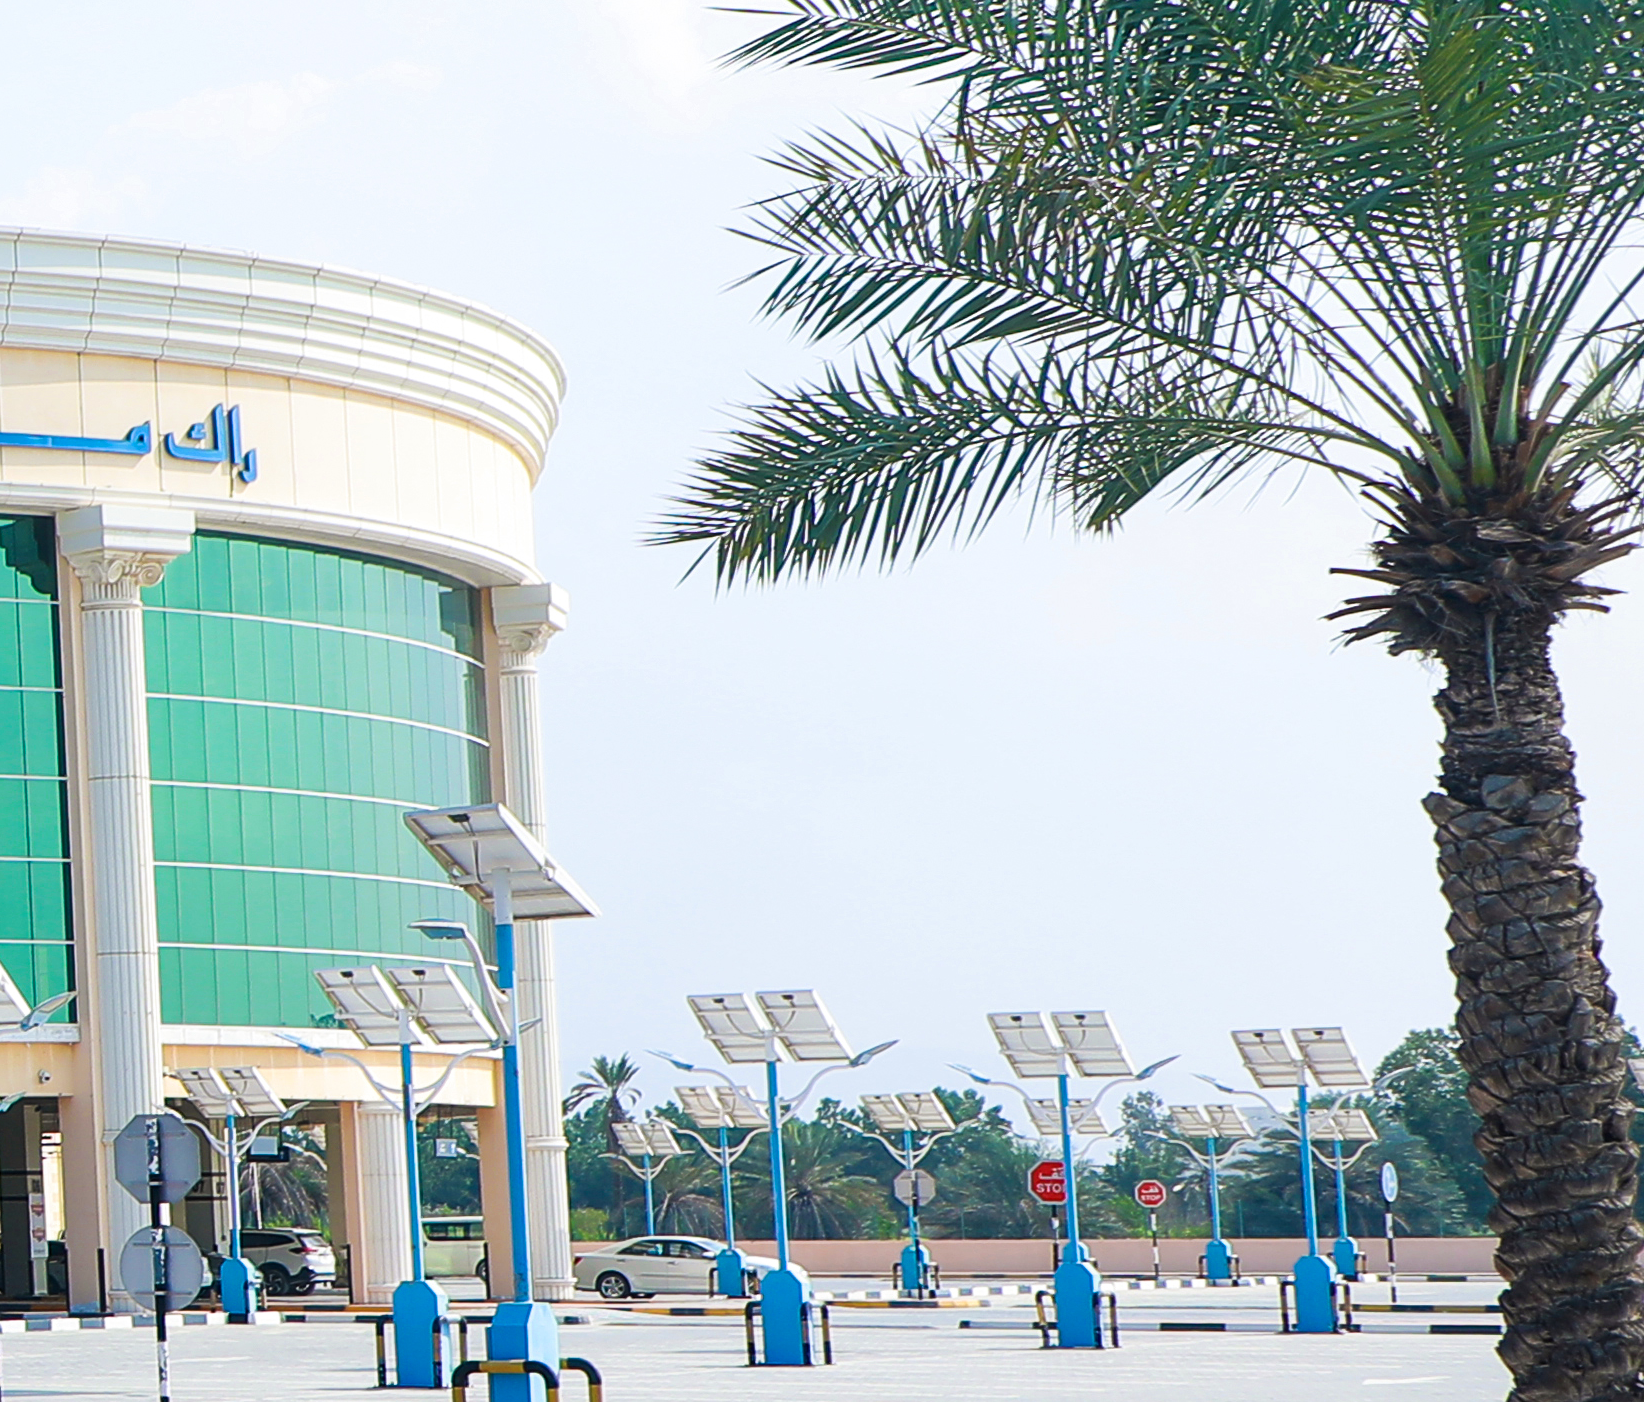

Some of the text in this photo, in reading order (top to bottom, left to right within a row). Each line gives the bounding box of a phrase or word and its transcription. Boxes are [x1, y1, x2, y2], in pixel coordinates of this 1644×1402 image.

[164, 402, 258, 484] راك
[1036, 1182, 1065, 1194] STO
[1140, 1194, 1161, 1202] STOP
